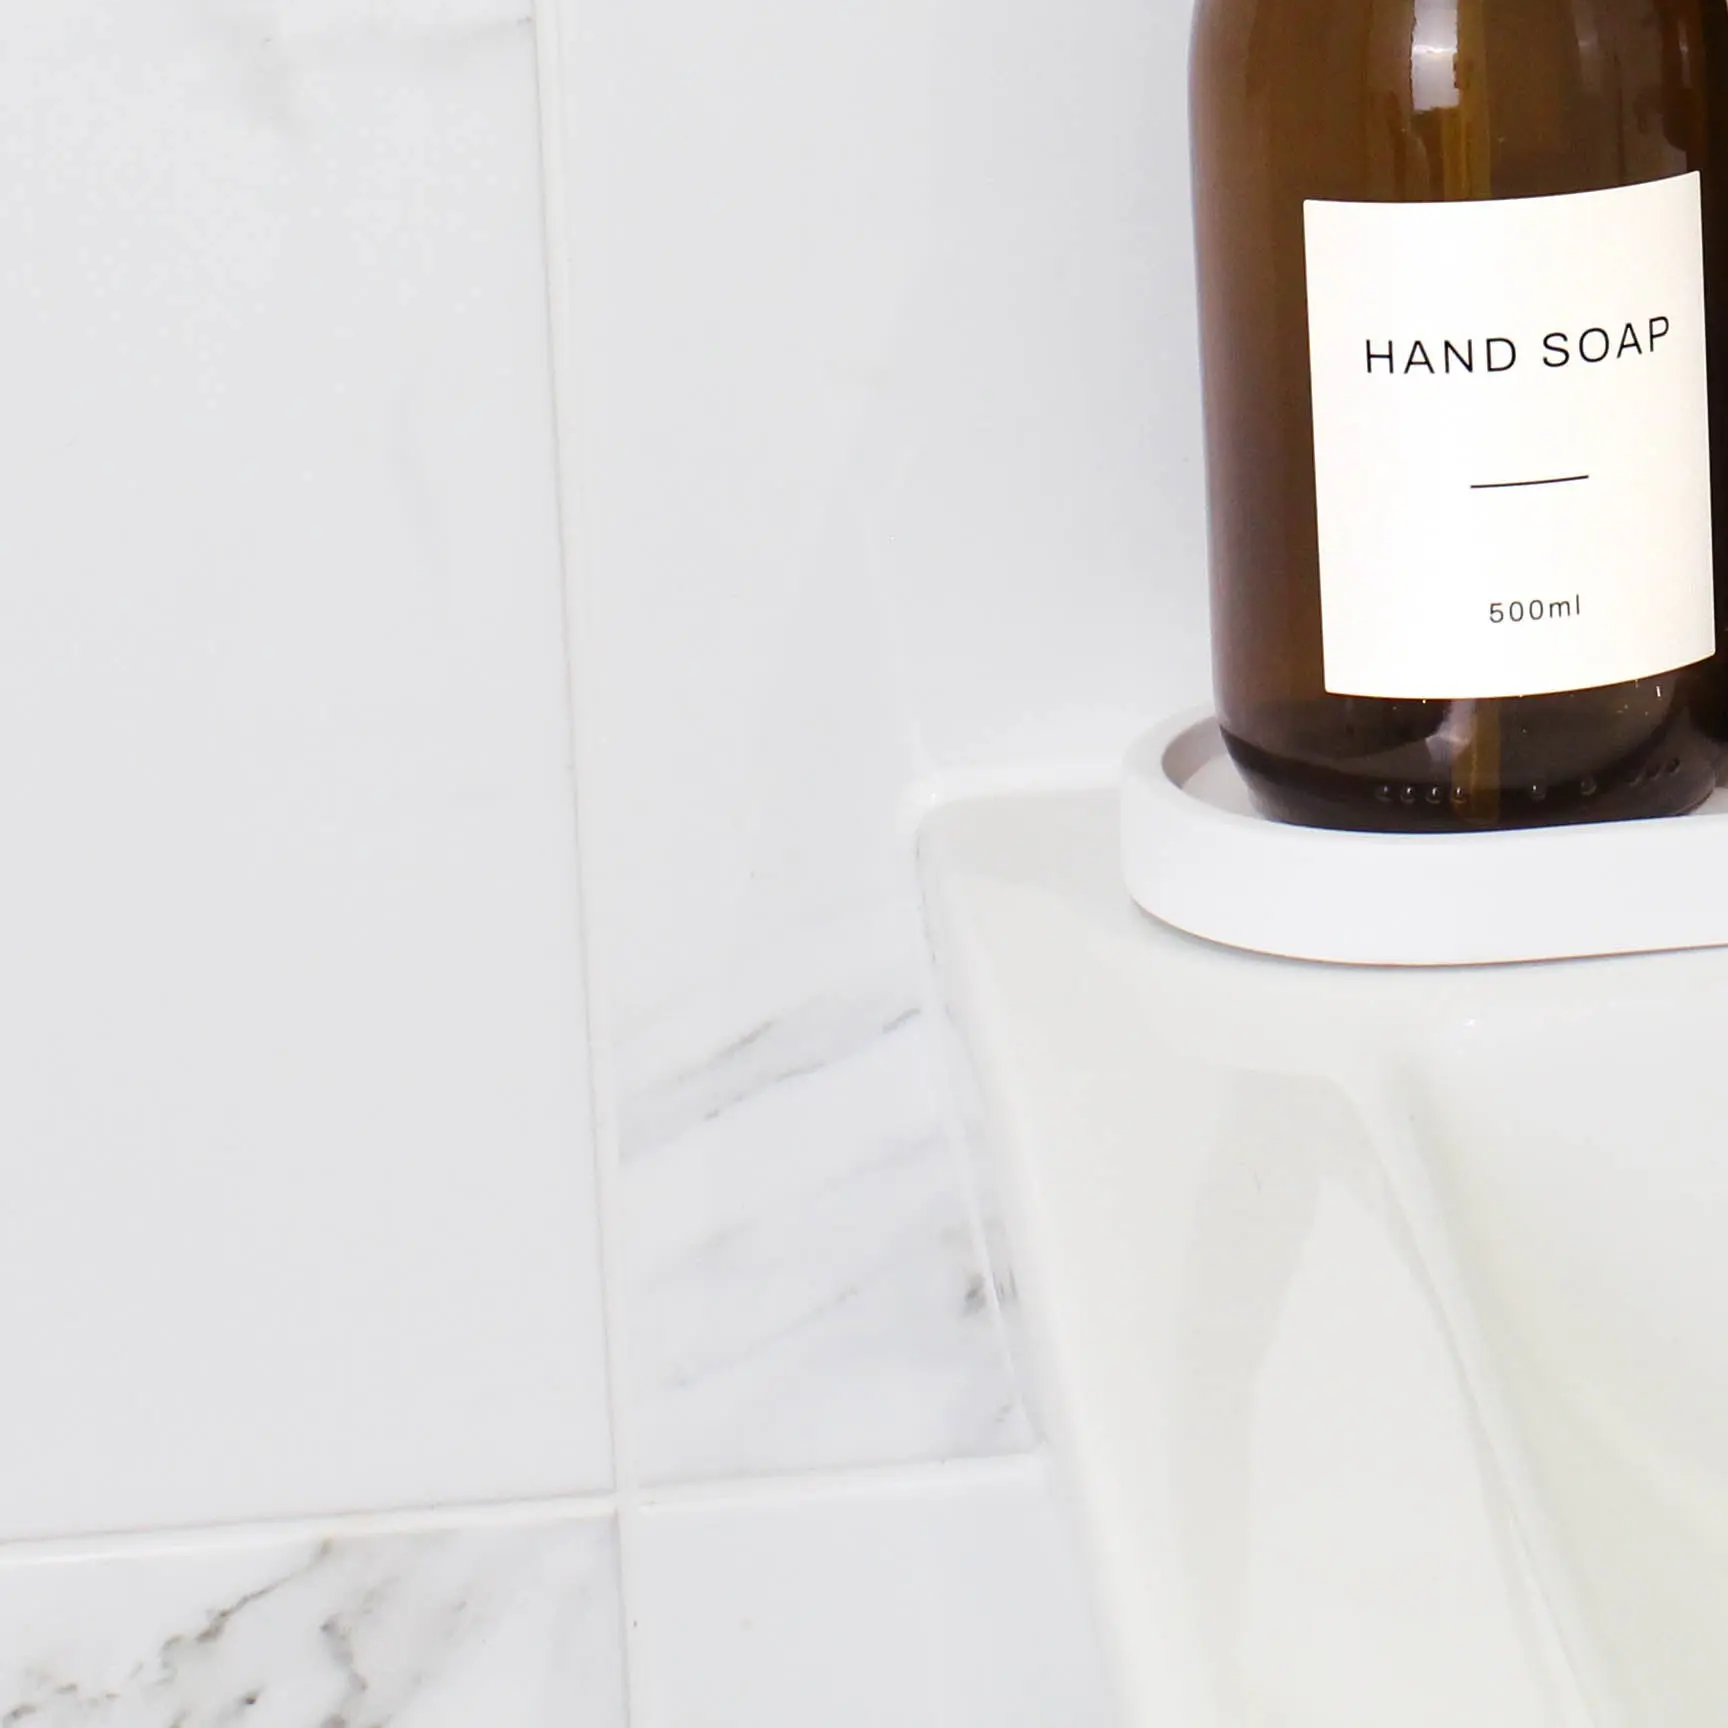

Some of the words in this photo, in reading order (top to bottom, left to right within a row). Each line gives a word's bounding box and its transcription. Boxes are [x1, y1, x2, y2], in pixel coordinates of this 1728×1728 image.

[1364, 337, 1518, 375] HAND
[1541, 315, 1670, 369] SOAP
[1489, 594, 1581, 624] 500ml
